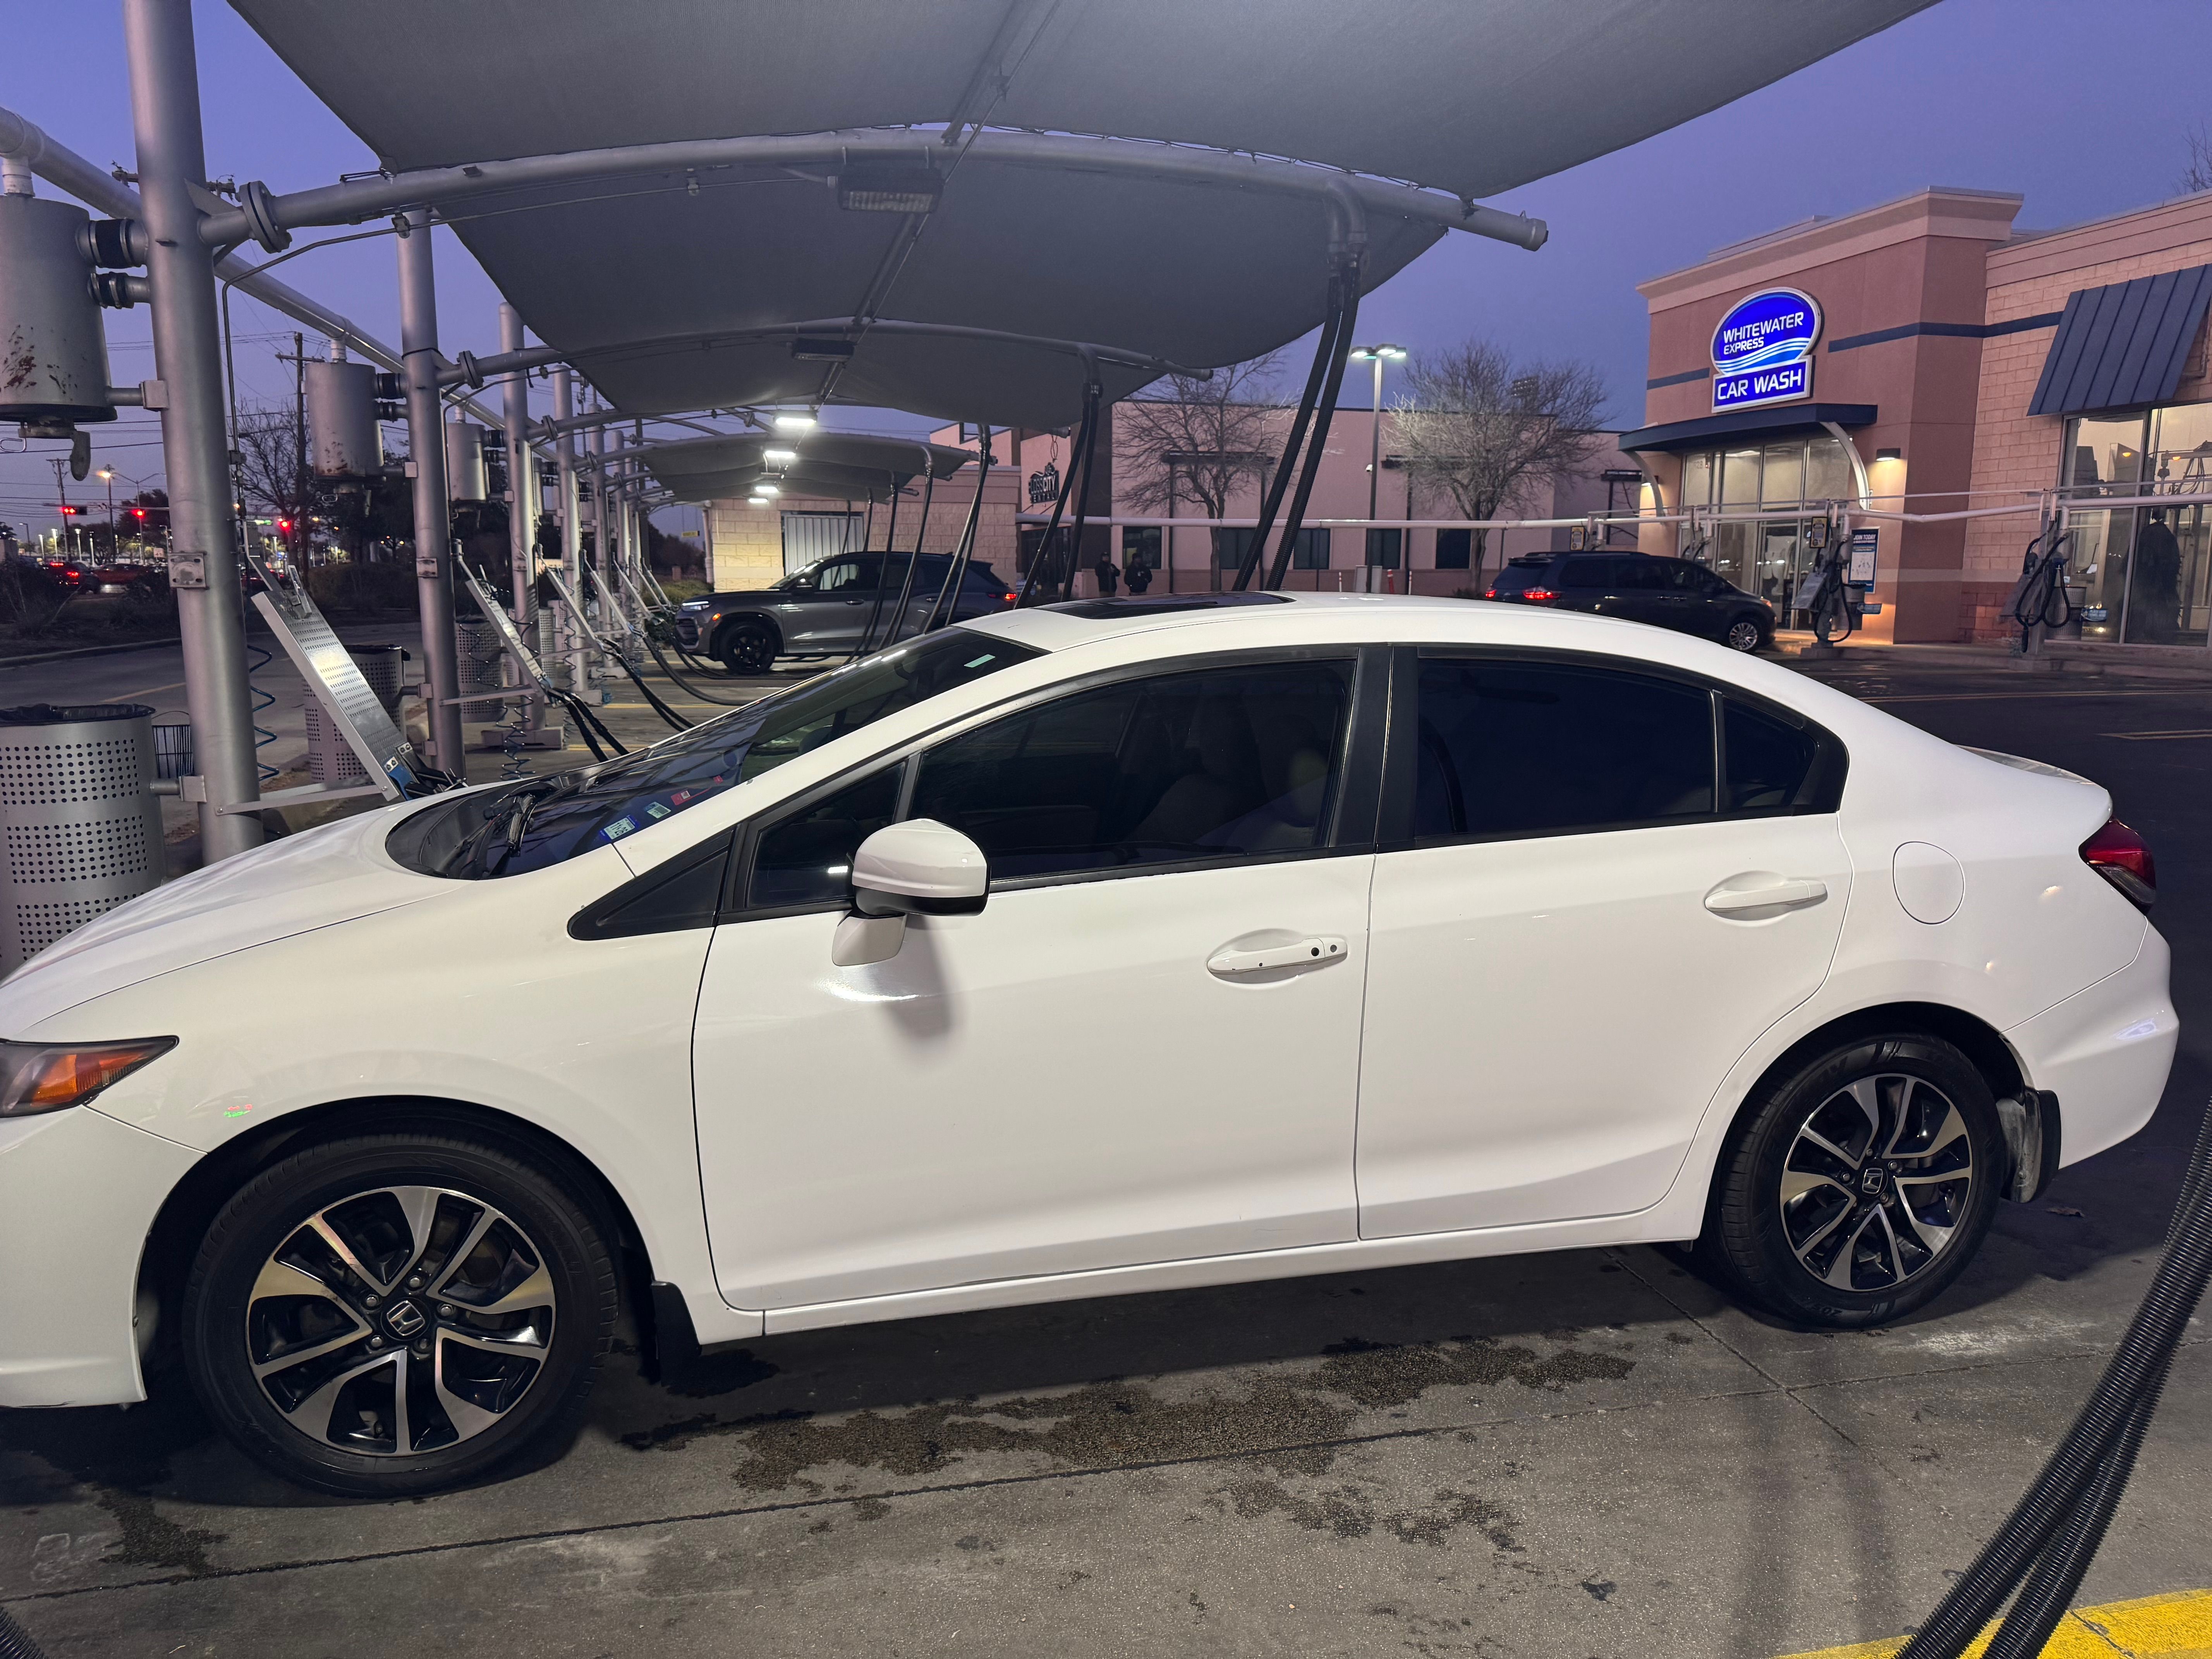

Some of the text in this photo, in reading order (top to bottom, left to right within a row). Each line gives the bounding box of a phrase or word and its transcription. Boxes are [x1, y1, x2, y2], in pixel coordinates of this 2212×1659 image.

[1724, 312, 1804, 343] WHITEWATER
[1724, 337, 1764, 355] EXPRESS
[1717, 368, 1802, 400] CAR WASH
